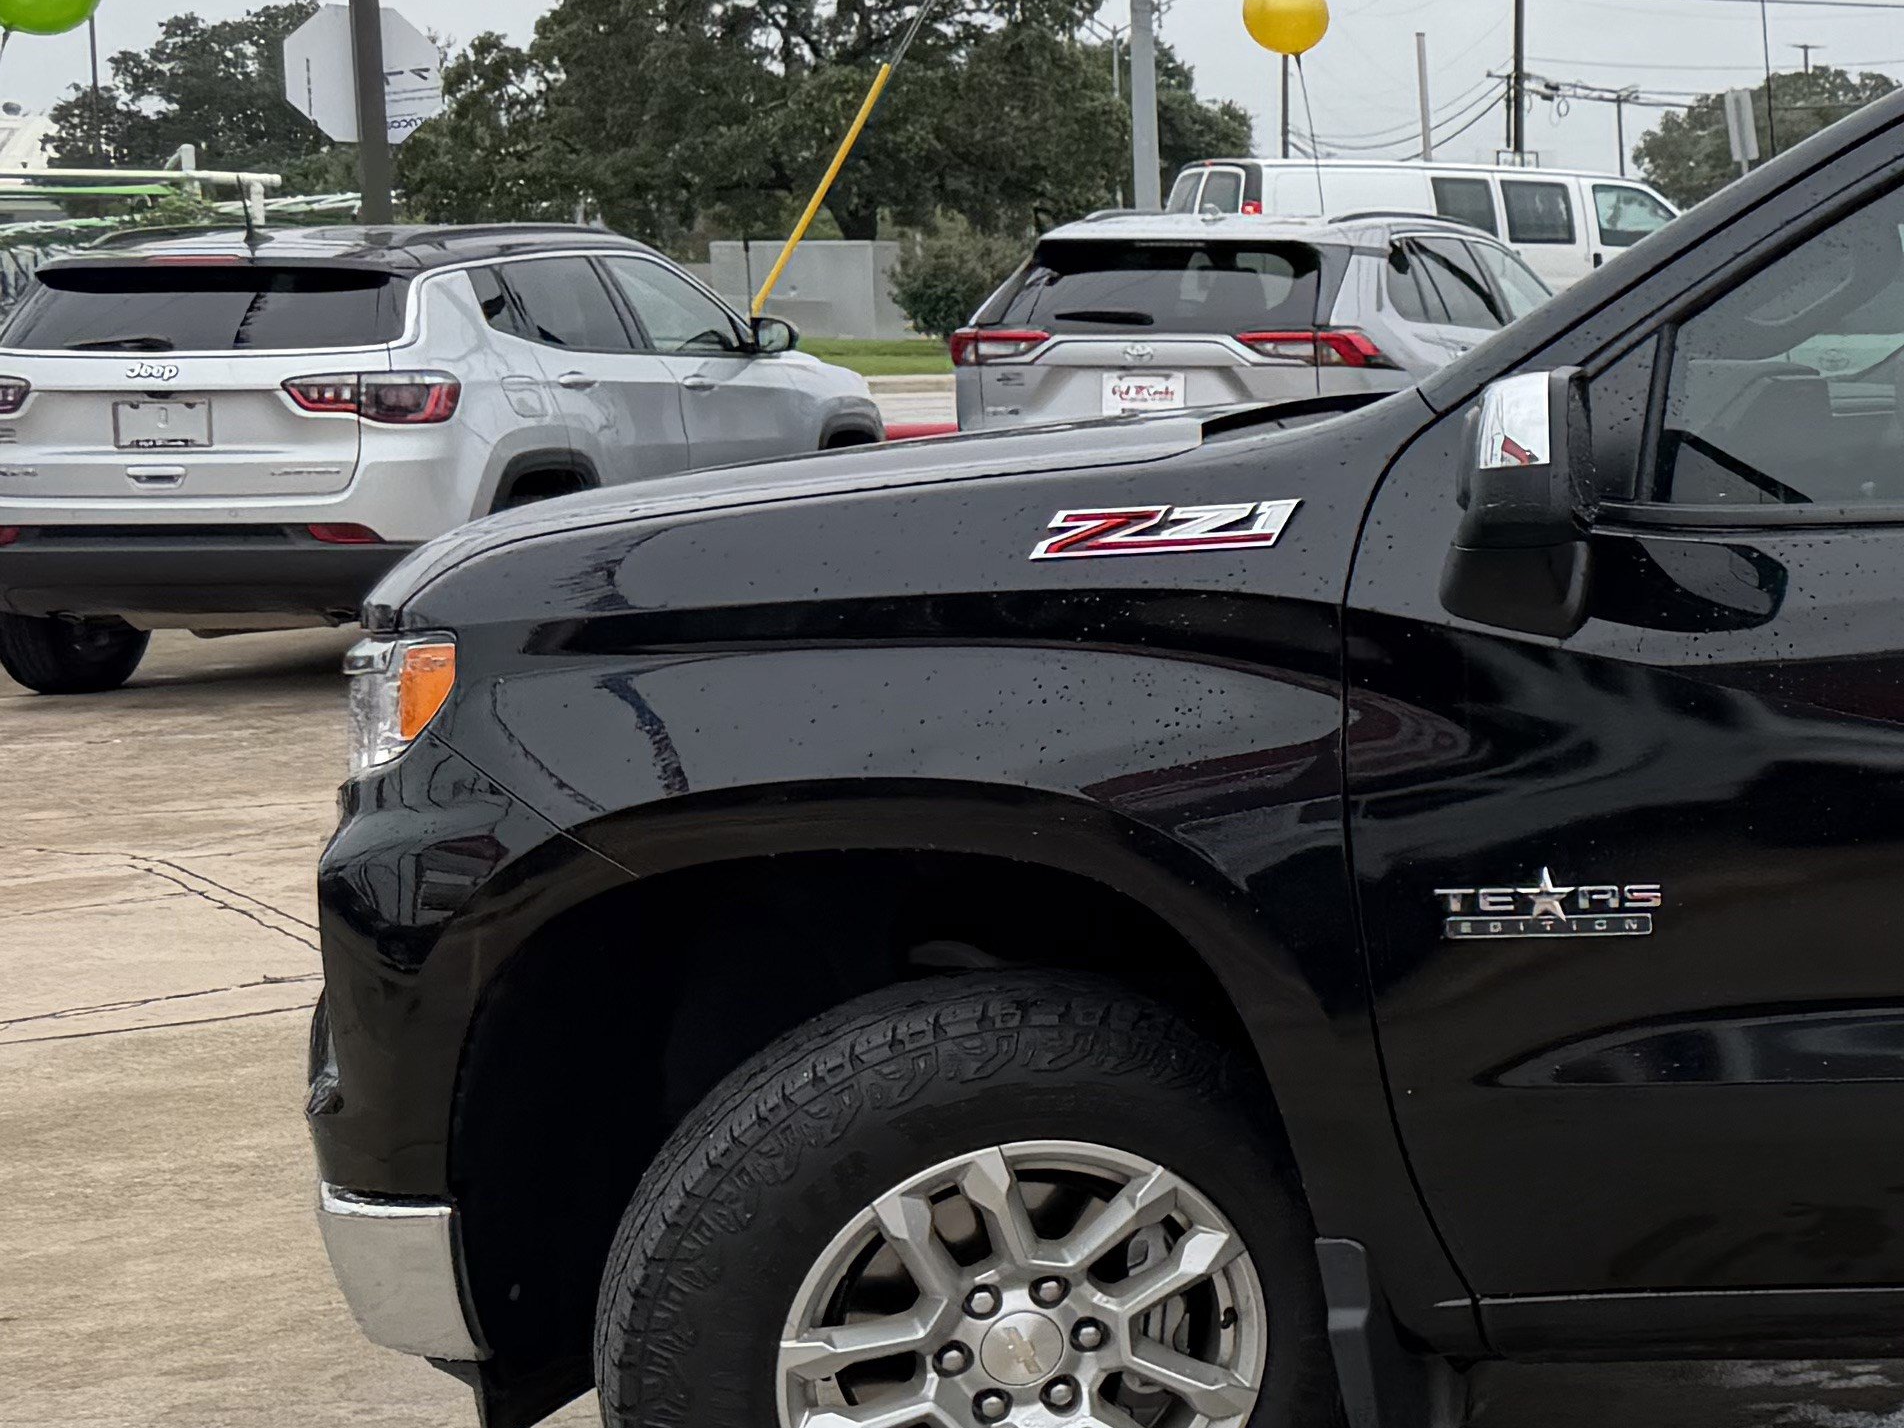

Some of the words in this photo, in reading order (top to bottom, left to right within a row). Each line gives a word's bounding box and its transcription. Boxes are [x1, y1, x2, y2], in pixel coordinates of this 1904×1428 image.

[126, 362, 179, 381] Jeep
[1028, 498, 1302, 560] Z71
[1460, 919, 1638, 934] EDITION
